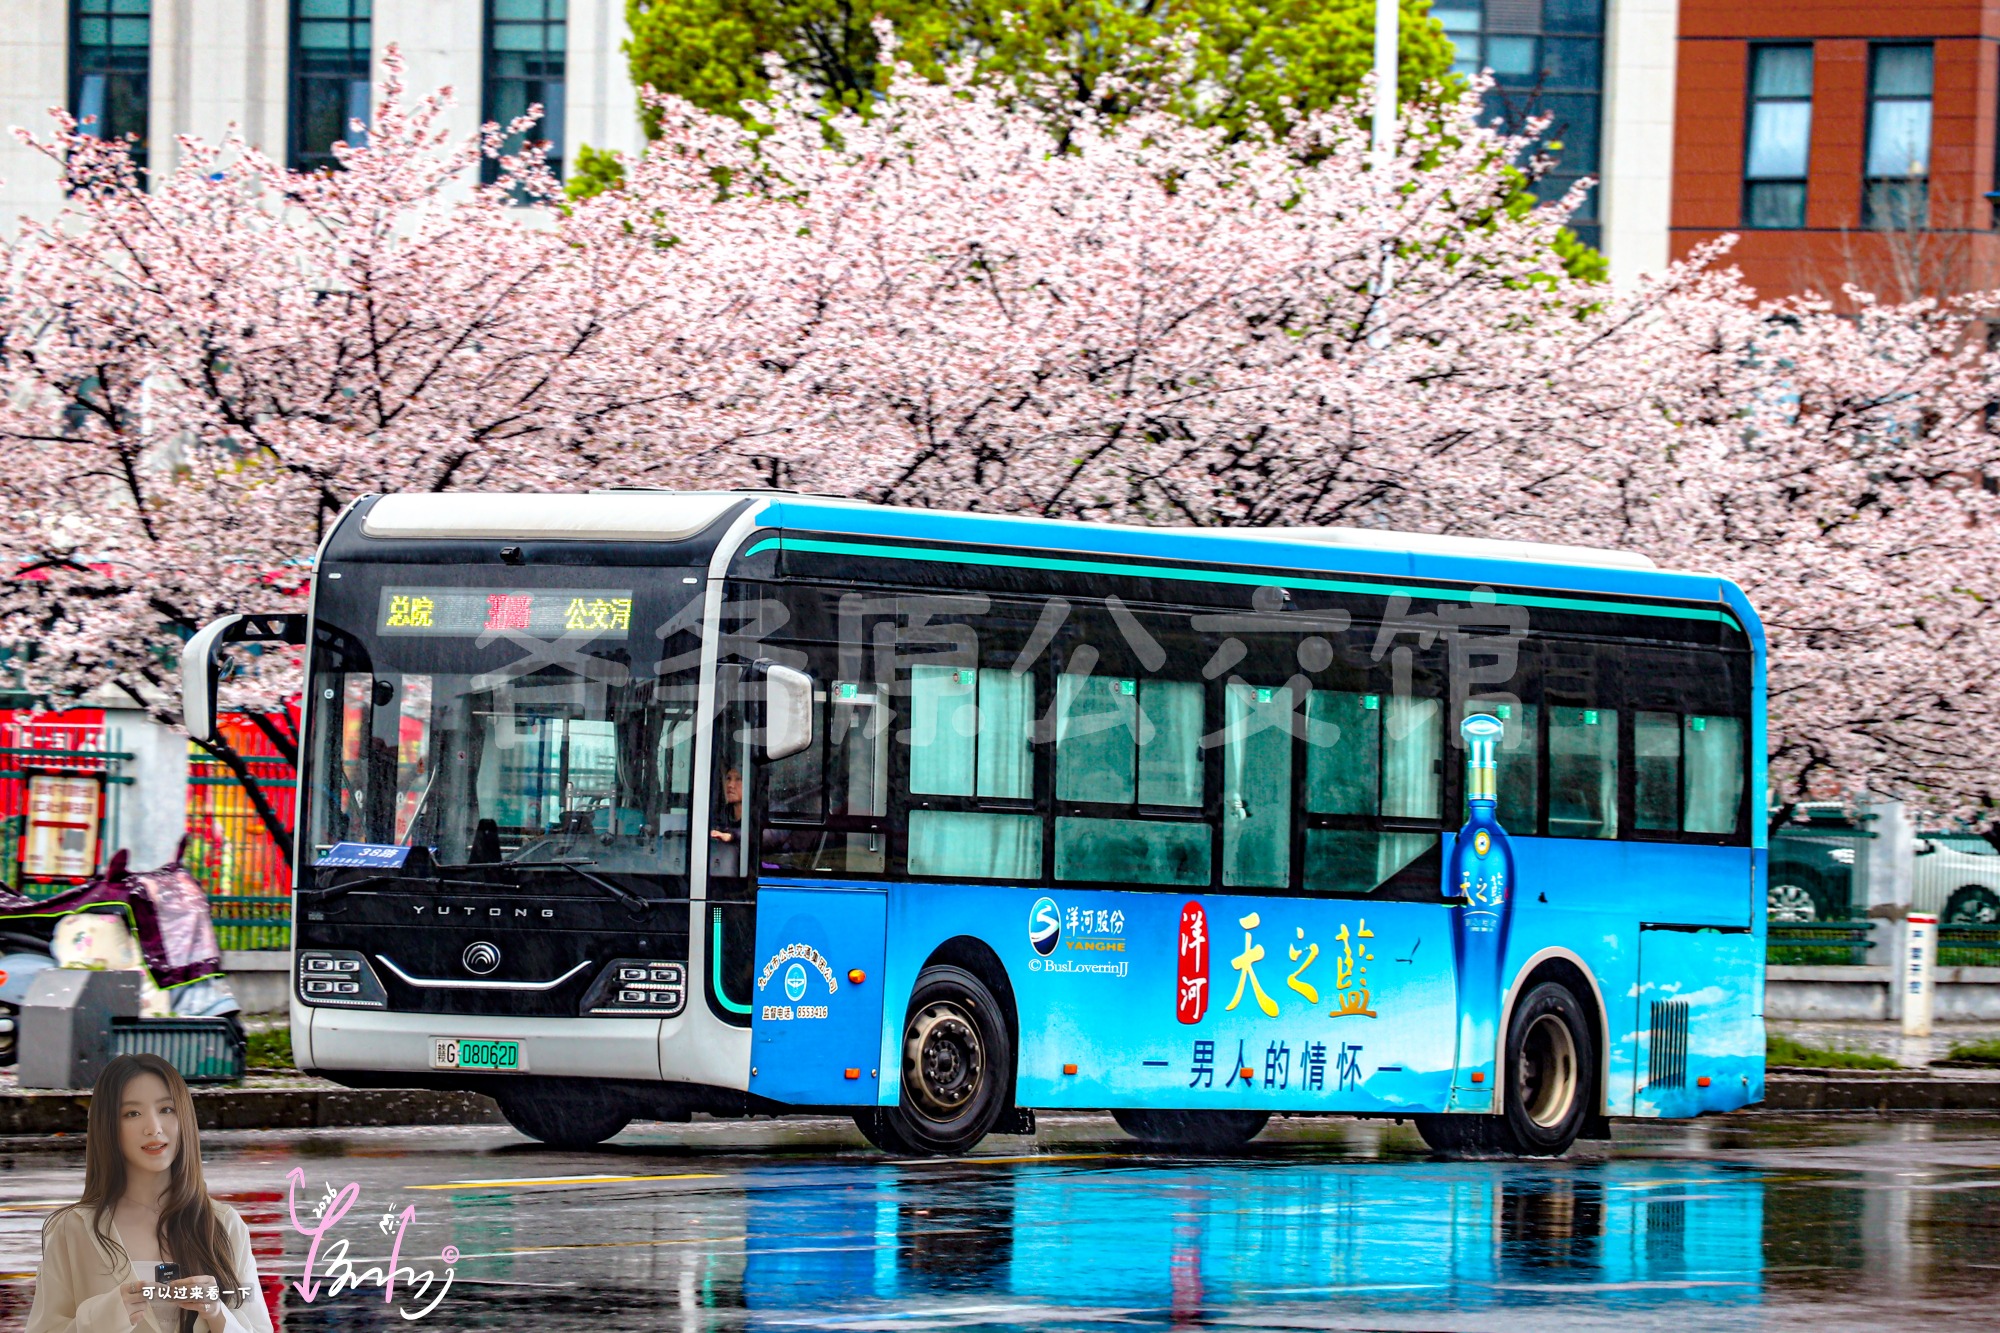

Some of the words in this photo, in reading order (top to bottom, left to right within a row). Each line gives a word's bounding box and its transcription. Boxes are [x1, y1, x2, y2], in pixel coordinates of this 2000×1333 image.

[386, 595, 434, 627] 总院
[413, 905, 554, 918] YUTONG
[1065, 906, 1125, 937] 洋河股份
[1065, 941, 1126, 952] YANGHE
[1180, 910, 1207, 1021] 洋河
[1188, 1038, 1364, 1092] 男人的情怀
